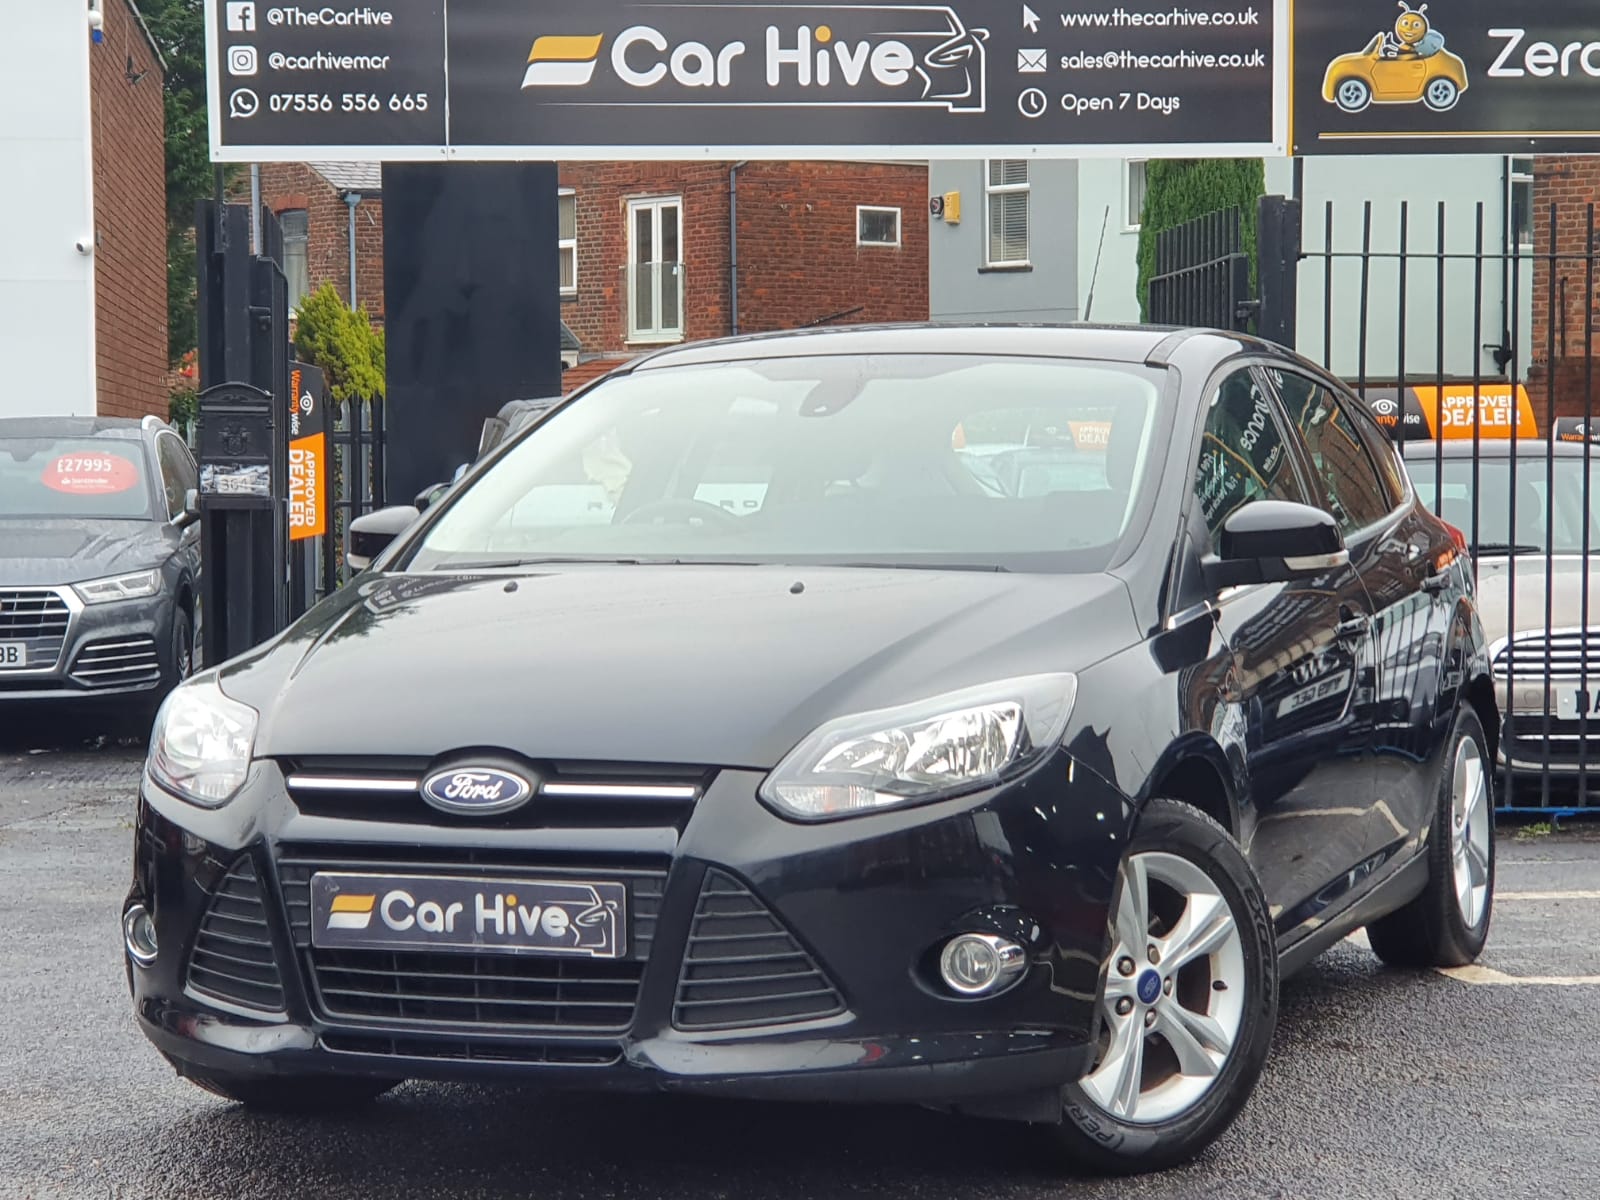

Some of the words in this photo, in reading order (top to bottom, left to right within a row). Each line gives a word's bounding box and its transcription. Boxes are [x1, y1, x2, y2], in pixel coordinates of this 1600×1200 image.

[267, 7, 393, 26] @TheCarHive
[1060, 7, 1259, 27] www.thecarhive.co.uk
[268, 51, 390, 70] @carhivemcr
[611, 26, 746, 87] Car
[766, 26, 914, 87] Hive
[1060, 49, 1265, 69] sales@thecarhive.co.uk
[269, 93, 333, 112] 07556
[341, 93, 381, 112] 556
[388, 93, 428, 112] 665
[1060, 93, 1113, 116] Open
[1119, 93, 1131, 110] 7
[1137, 92, 1181, 115] Days
[57, 458, 112, 473] £27995
[289, 449, 305, 527] DEALER
[304, 449, 316, 527] APPROVED
[445, 774, 503, 799] Ford
[380, 890, 463, 933] Car
[475, 893, 571, 938] Hive
